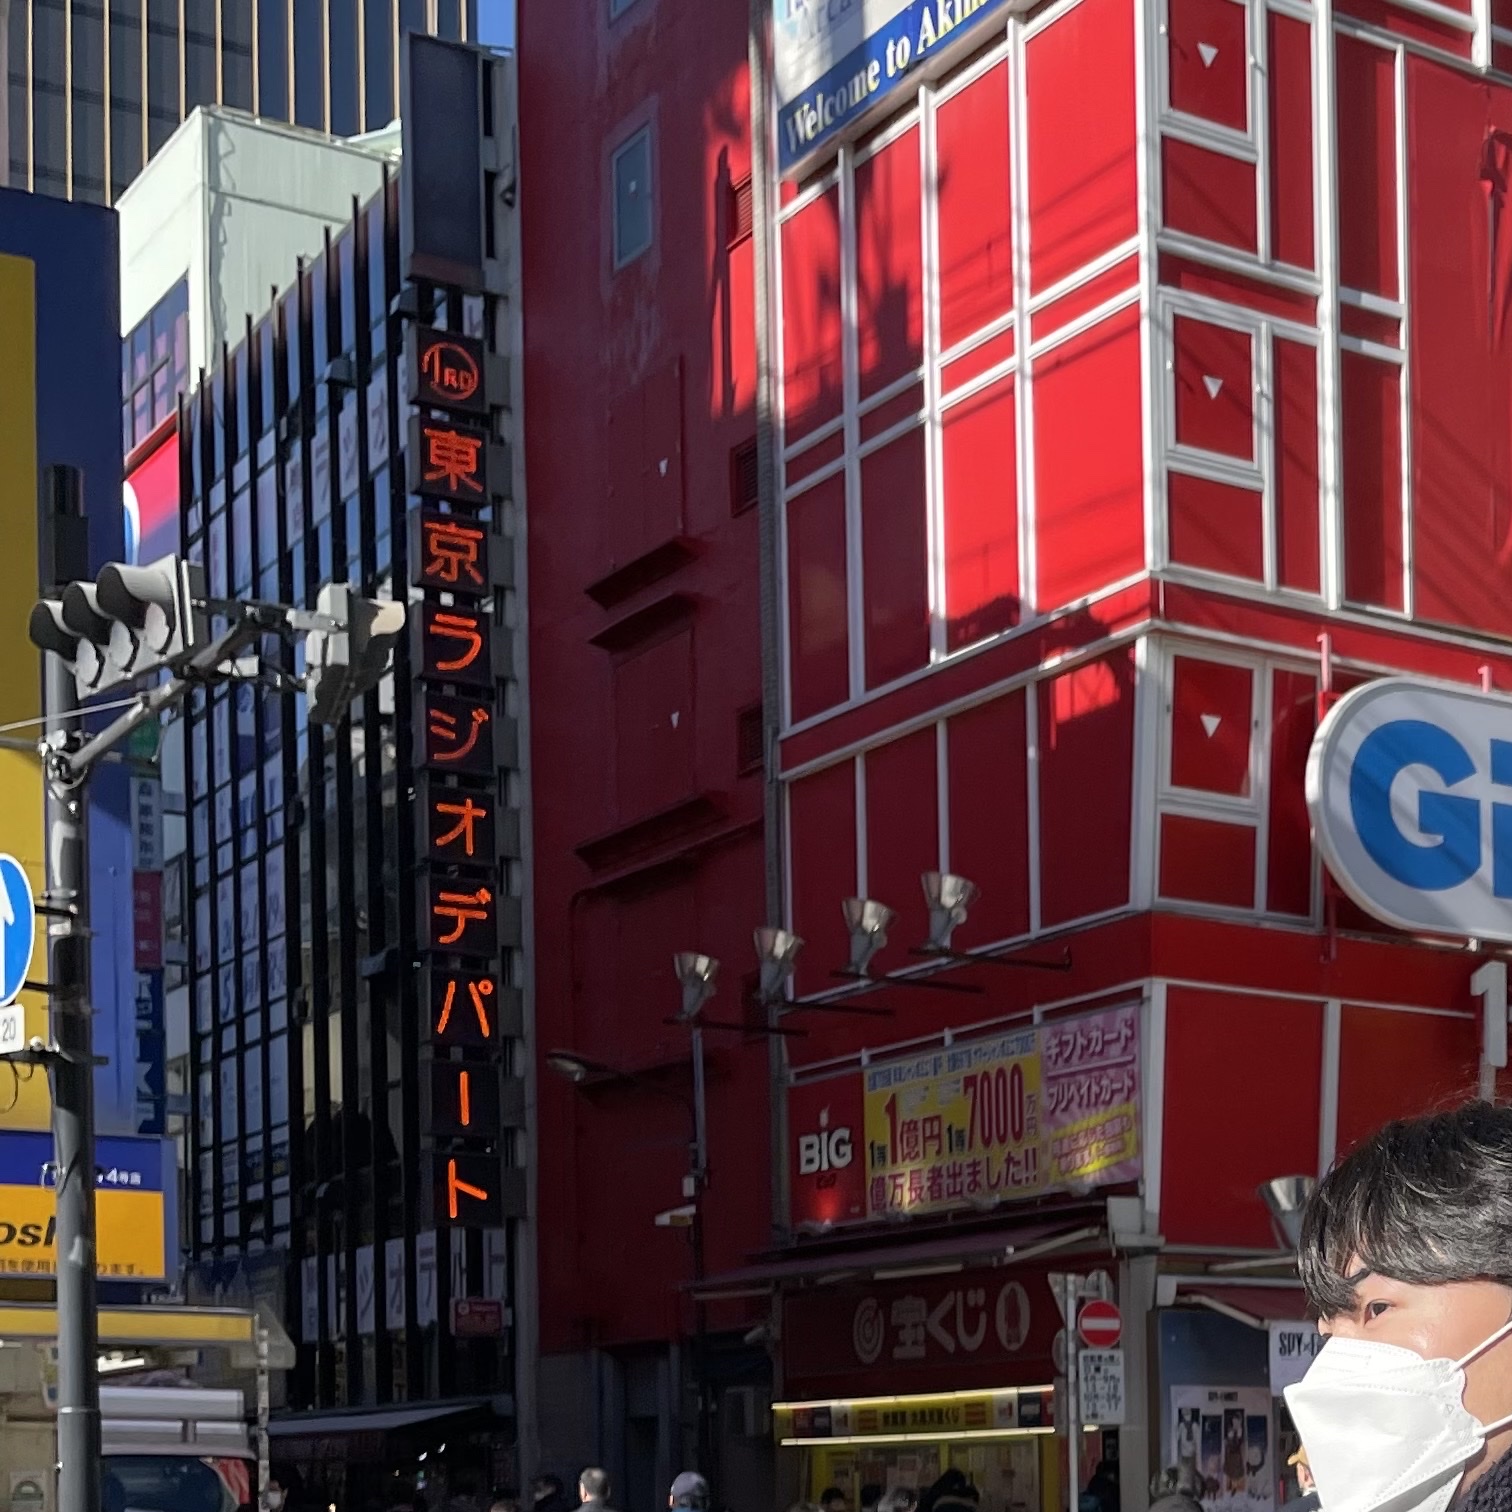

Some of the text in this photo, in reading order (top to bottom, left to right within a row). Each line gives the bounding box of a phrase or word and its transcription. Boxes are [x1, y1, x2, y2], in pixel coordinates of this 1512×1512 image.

[785, 59, 880, 153] Welcome
[886, 35, 911, 78] to
[423, 427, 492, 1220] 東京ラジオデパート
[890, 1286, 988, 1360] 宝くじ
